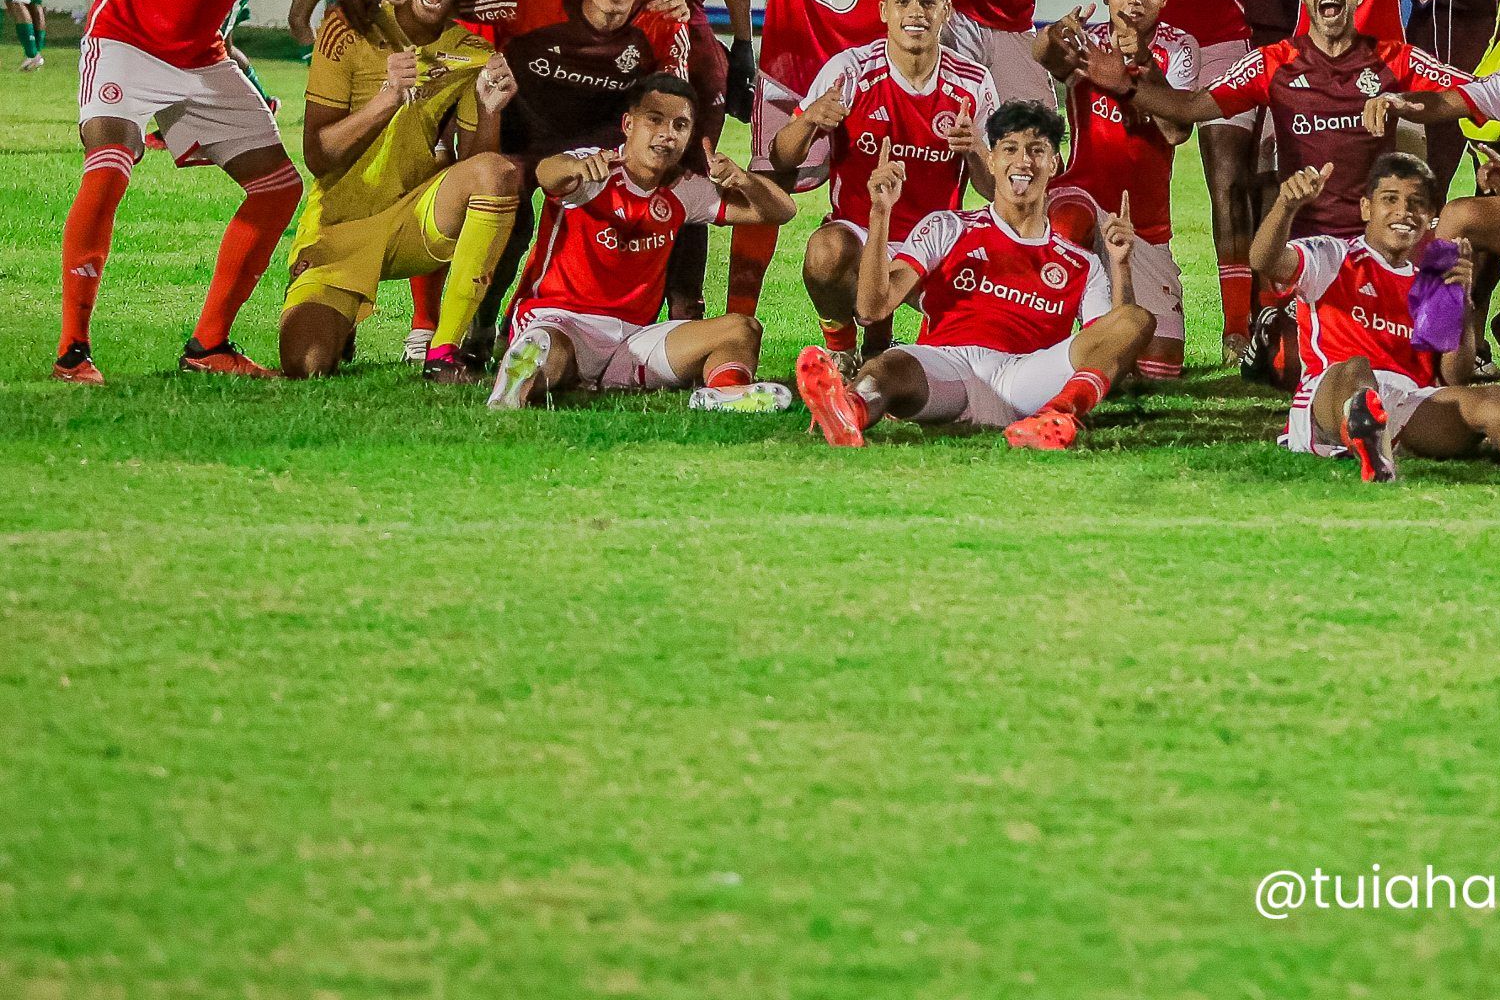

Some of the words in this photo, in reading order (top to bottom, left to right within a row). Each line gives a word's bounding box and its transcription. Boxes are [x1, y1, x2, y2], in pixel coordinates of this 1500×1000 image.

[475, 8, 508, 22] vero
[332, 32, 356, 62] vero
[1227, 67, 1257, 90] vero
[1409, 56, 1439, 81] vero
[912, 215, 941, 243] vero
[979, 276, 1064, 315] banrisul
